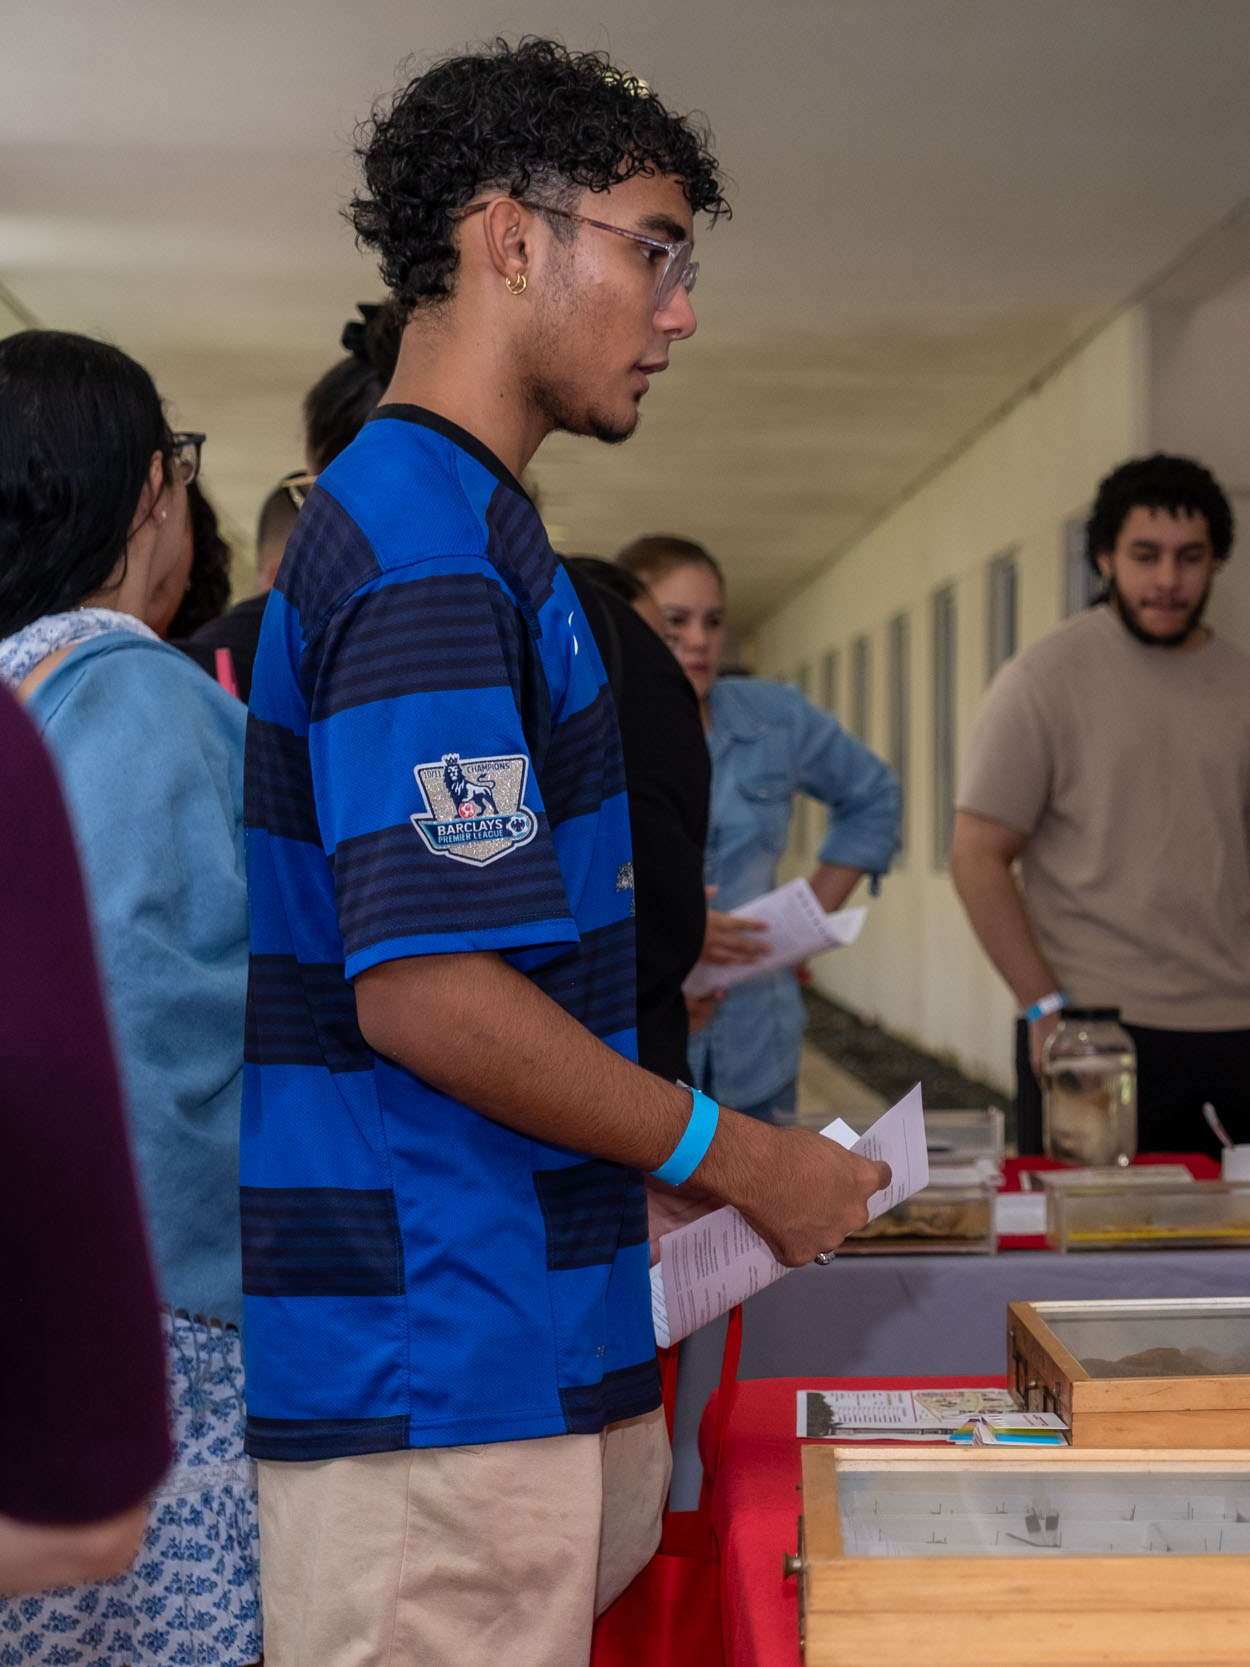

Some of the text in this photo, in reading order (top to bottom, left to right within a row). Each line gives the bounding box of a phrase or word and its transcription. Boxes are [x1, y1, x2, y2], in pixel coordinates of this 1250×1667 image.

[424, 762, 510, 779] 10/11 CHAMPIONS
[437, 819, 503, 836] BARCLAYS
[438, 829, 503, 844] PREMIER LEAGUE
